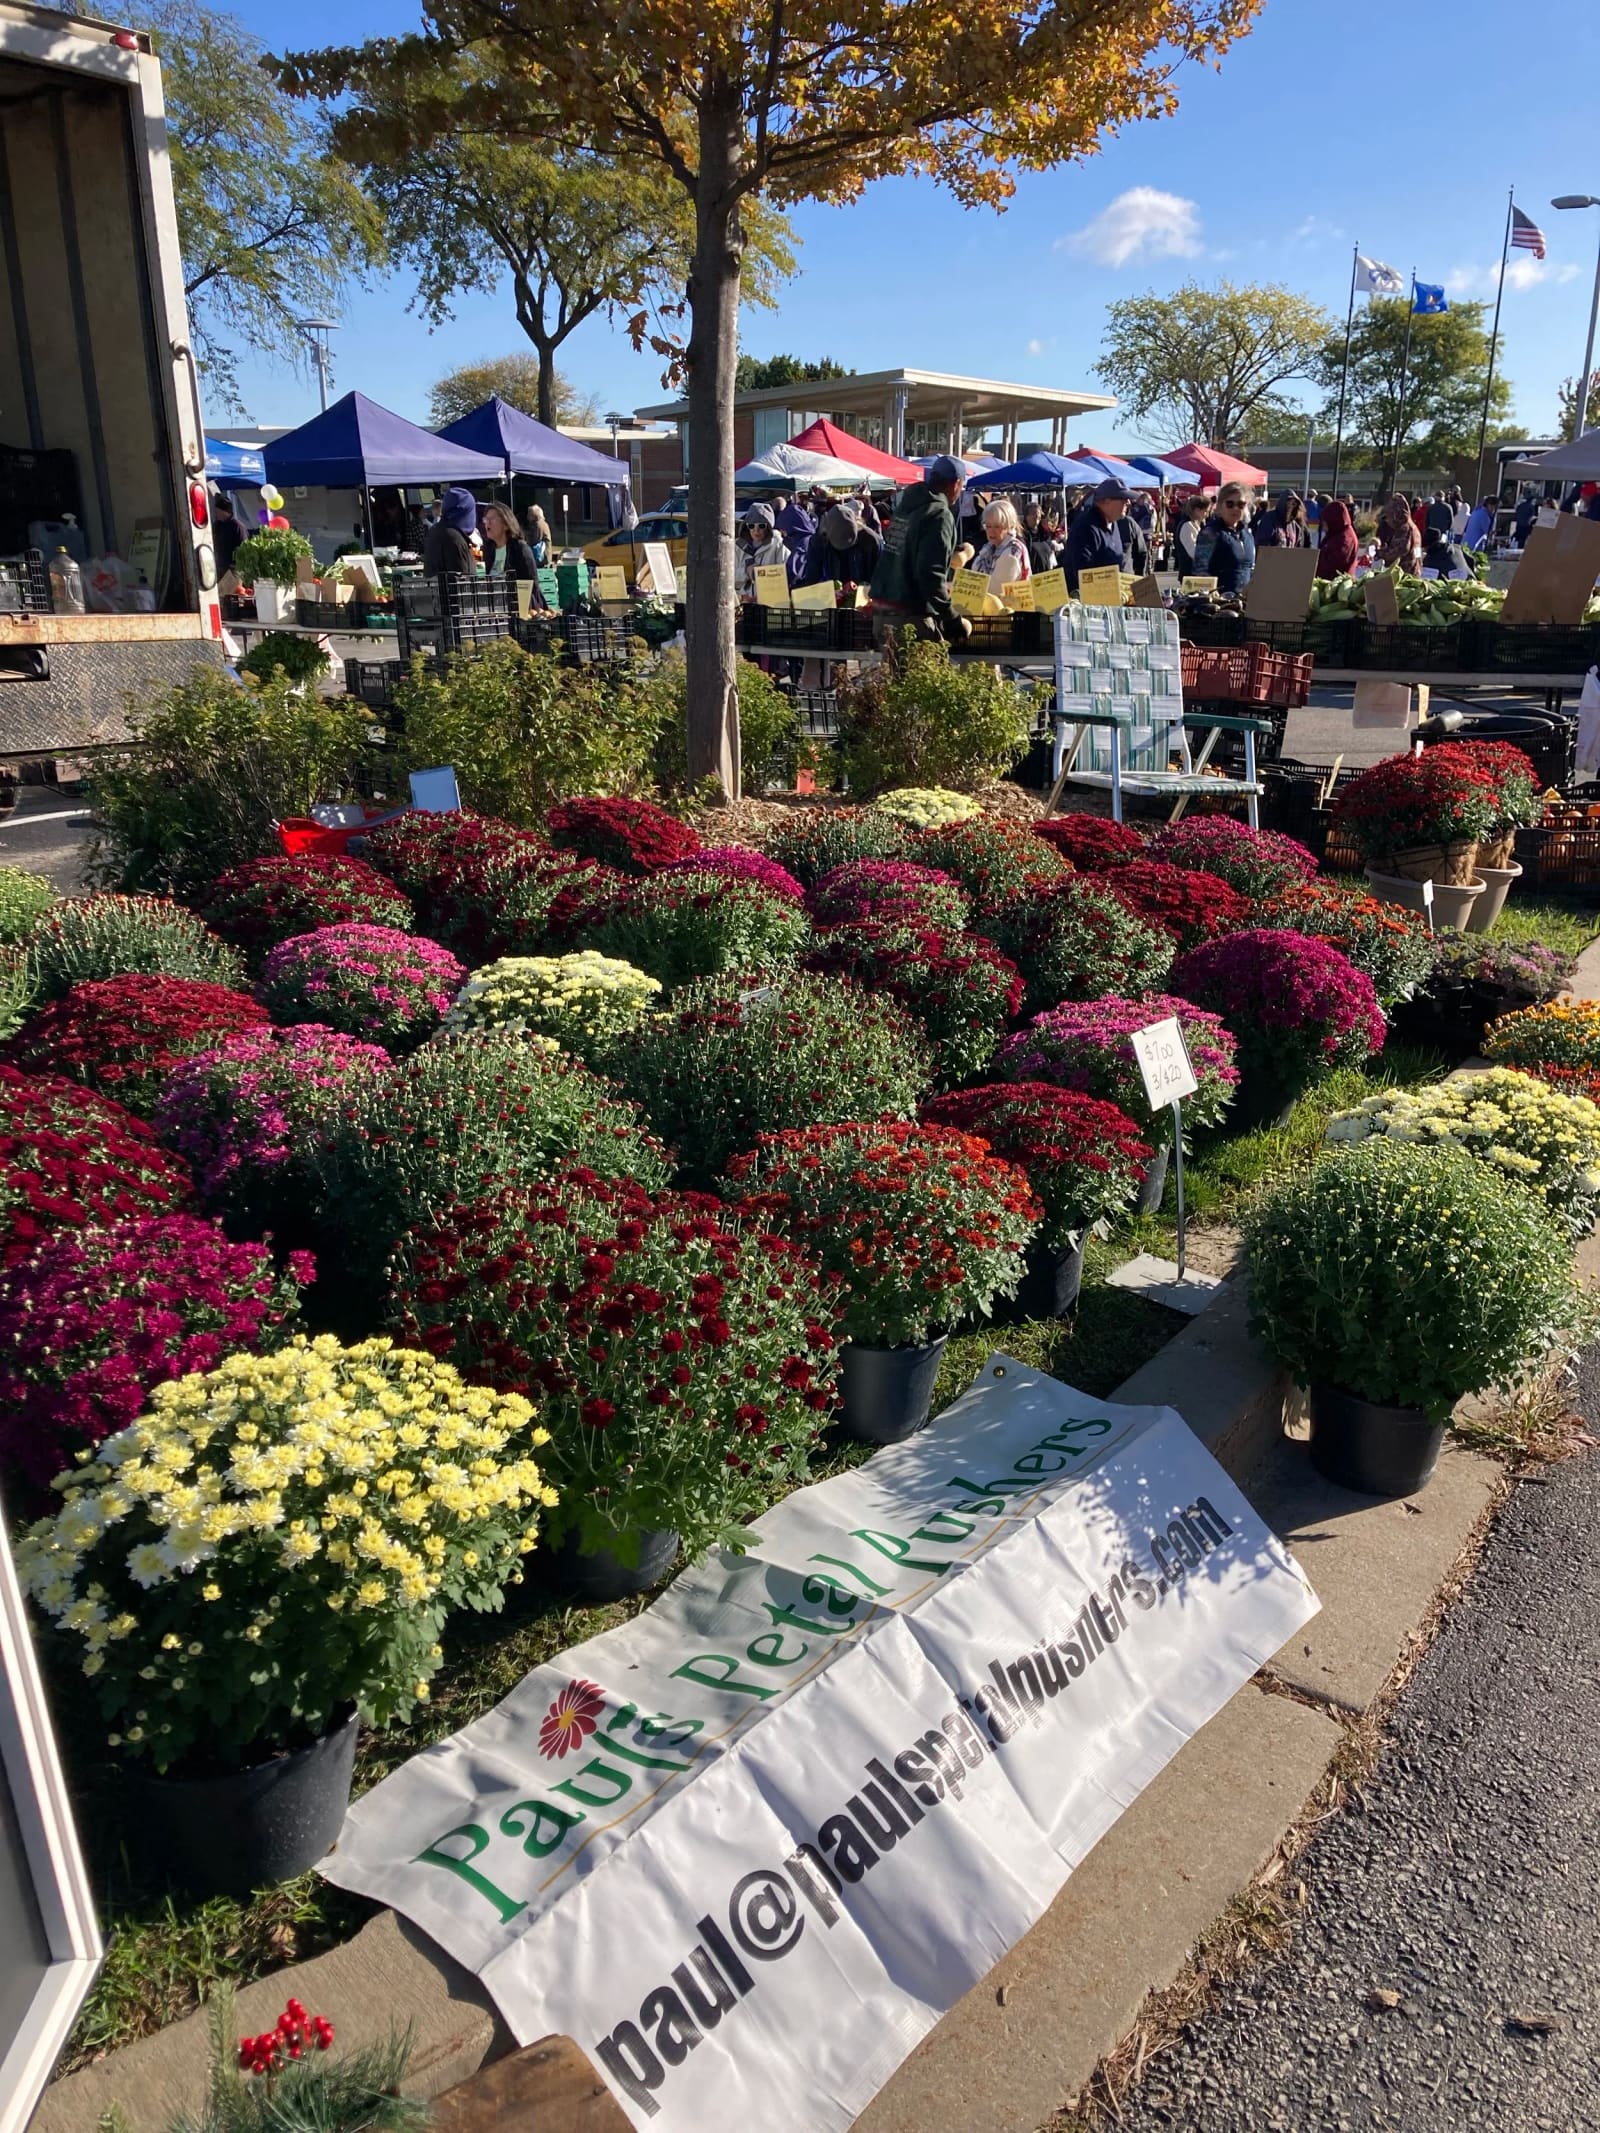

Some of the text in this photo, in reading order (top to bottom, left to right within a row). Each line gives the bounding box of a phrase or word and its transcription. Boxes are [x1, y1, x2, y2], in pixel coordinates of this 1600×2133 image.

[409, 1417, 1113, 1925] Paul's Petal Pushers
